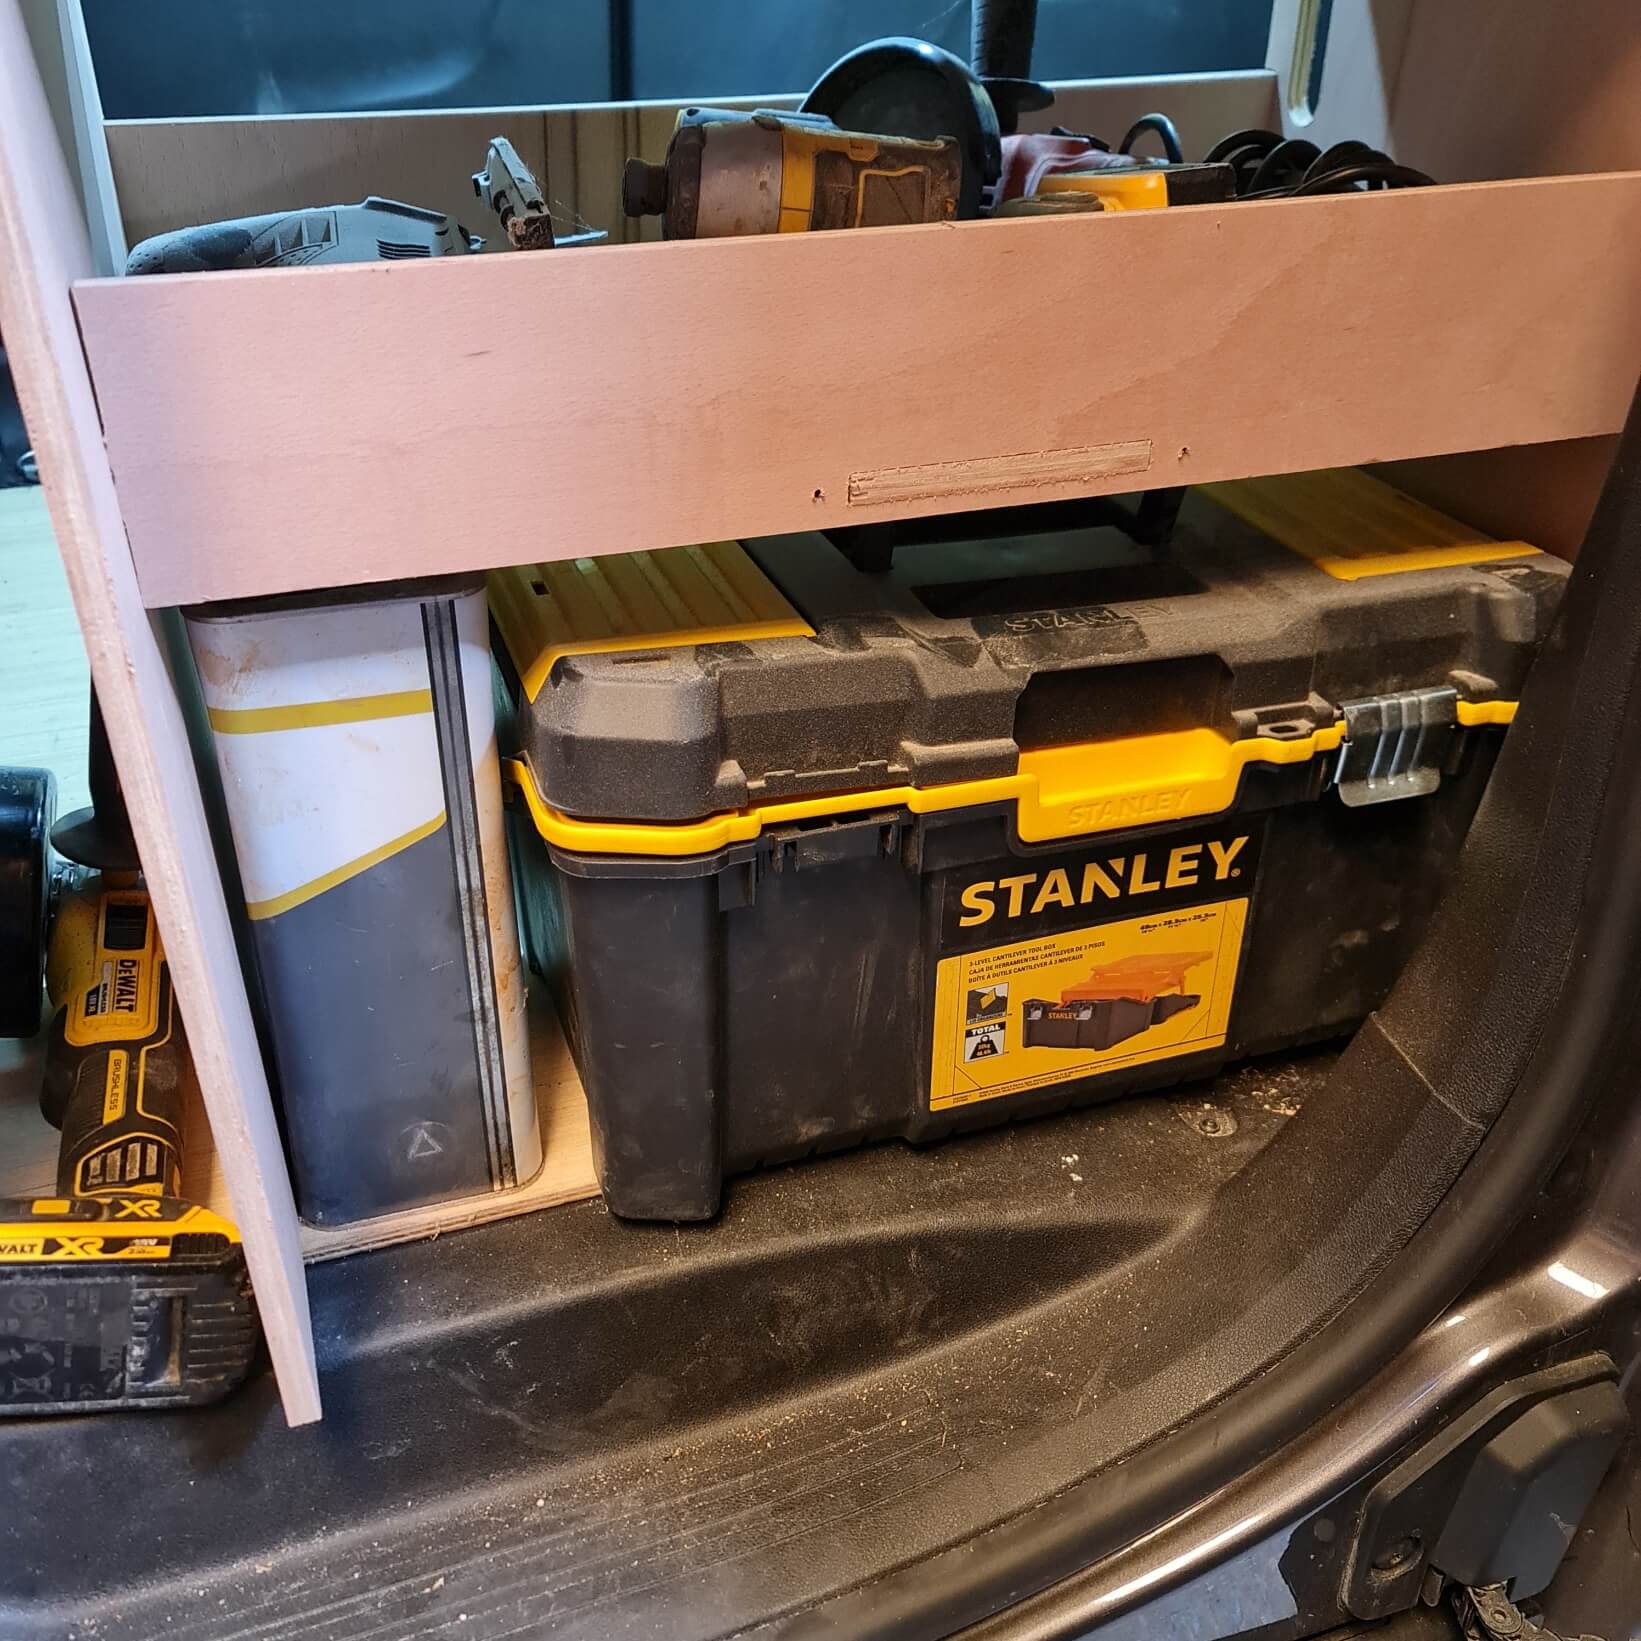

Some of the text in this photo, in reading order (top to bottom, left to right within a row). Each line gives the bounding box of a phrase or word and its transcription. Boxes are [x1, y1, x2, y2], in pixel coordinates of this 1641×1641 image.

[1068, 790, 1193, 829] STANLEY
[959, 836, 1249, 927] STANLEY
[969, 967, 985, 975] CAJA
[985, 964, 993, 972] DE
[1040, 947, 1075, 960] CANTILEVER
[992, 949, 1027, 962] CANTILEVER
[1028, 946, 1042, 954] TOOL
[1013, 961, 1048, 974] CANTILEVER
[115, 959, 137, 1013] DEWALT
[1048, 1012, 1078, 1020] STANLEY
[971, 1023, 1001, 1036] TOTAL
[109, 1058, 122, 1111] BRUSHLESS
[114, 1199, 162, 1218] XR
[55, 1236, 105, 1256] XR
